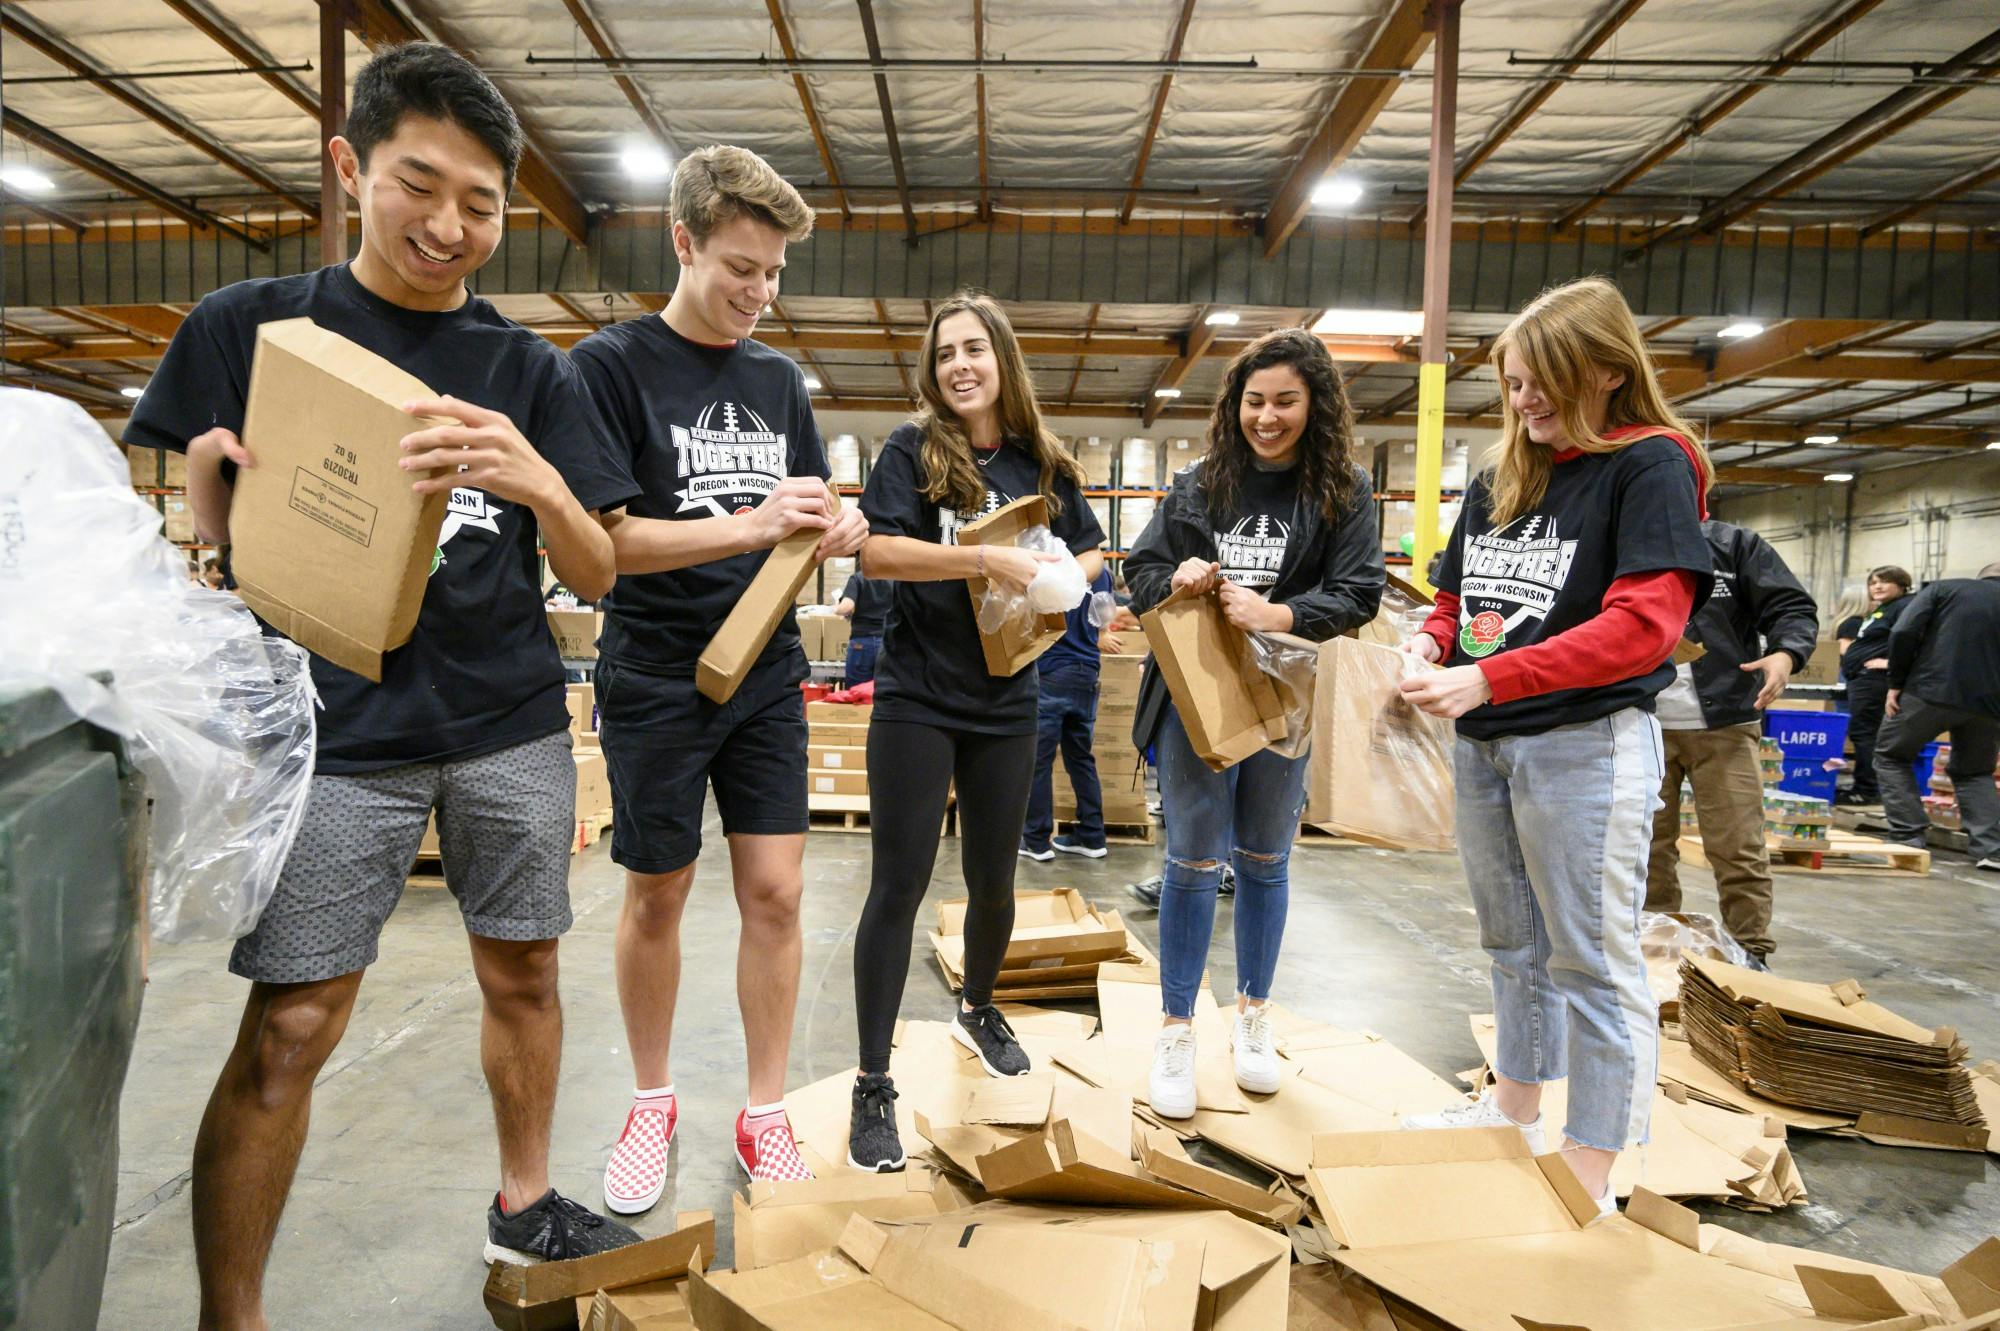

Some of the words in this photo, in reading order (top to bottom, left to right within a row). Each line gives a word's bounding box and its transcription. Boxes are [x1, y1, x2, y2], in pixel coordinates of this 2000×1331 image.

[347, 451, 357, 465] 16
[670, 424, 787, 478] TOGETHER
[323, 458, 359, 486] TR30219
[694, 480, 729, 492] OREGON
[1494, 583, 1549, 602] WISCONSIN
[1480, 600, 1502, 609] 2020
[1780, 731, 1827, 745] LARFB
